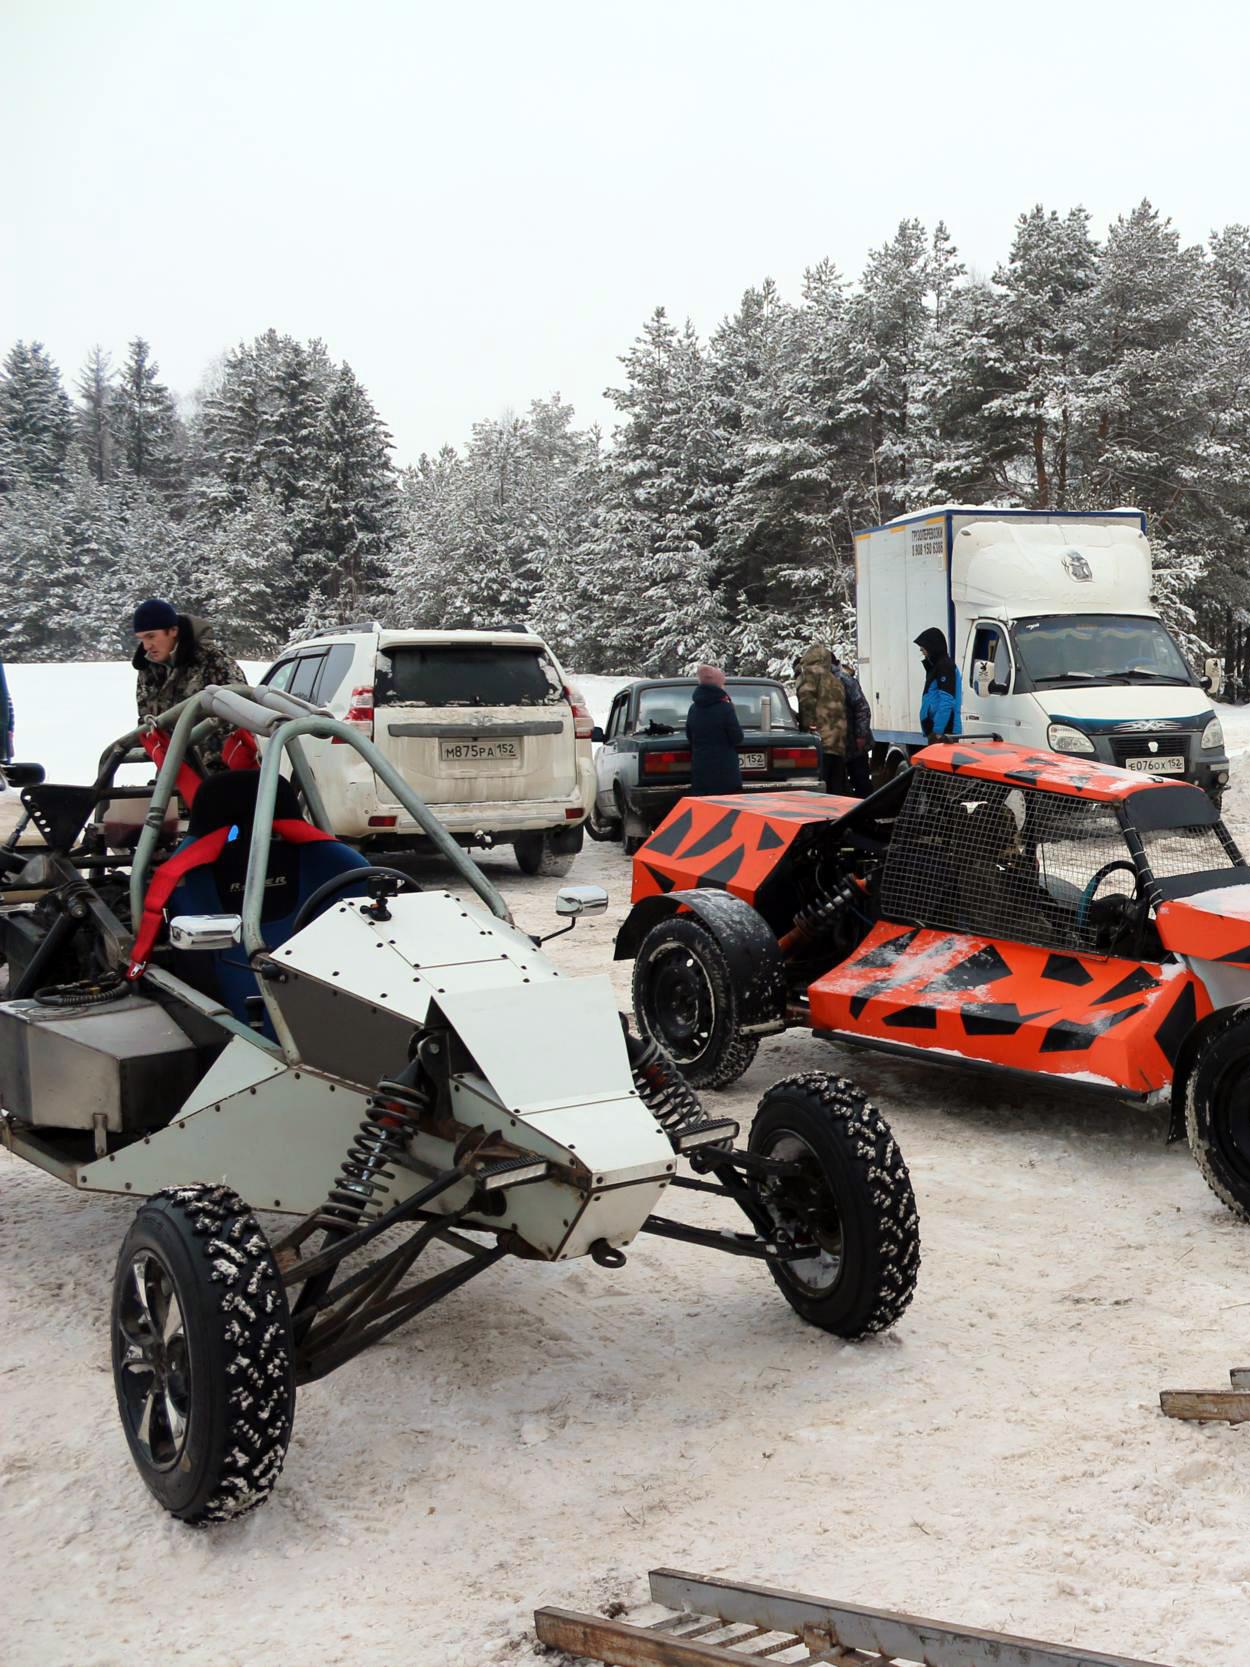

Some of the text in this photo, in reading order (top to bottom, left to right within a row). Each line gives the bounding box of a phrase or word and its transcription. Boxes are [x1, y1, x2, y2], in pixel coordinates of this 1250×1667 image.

[446, 743, 515, 758] М875РА 152
[746, 754, 763, 763] 152
